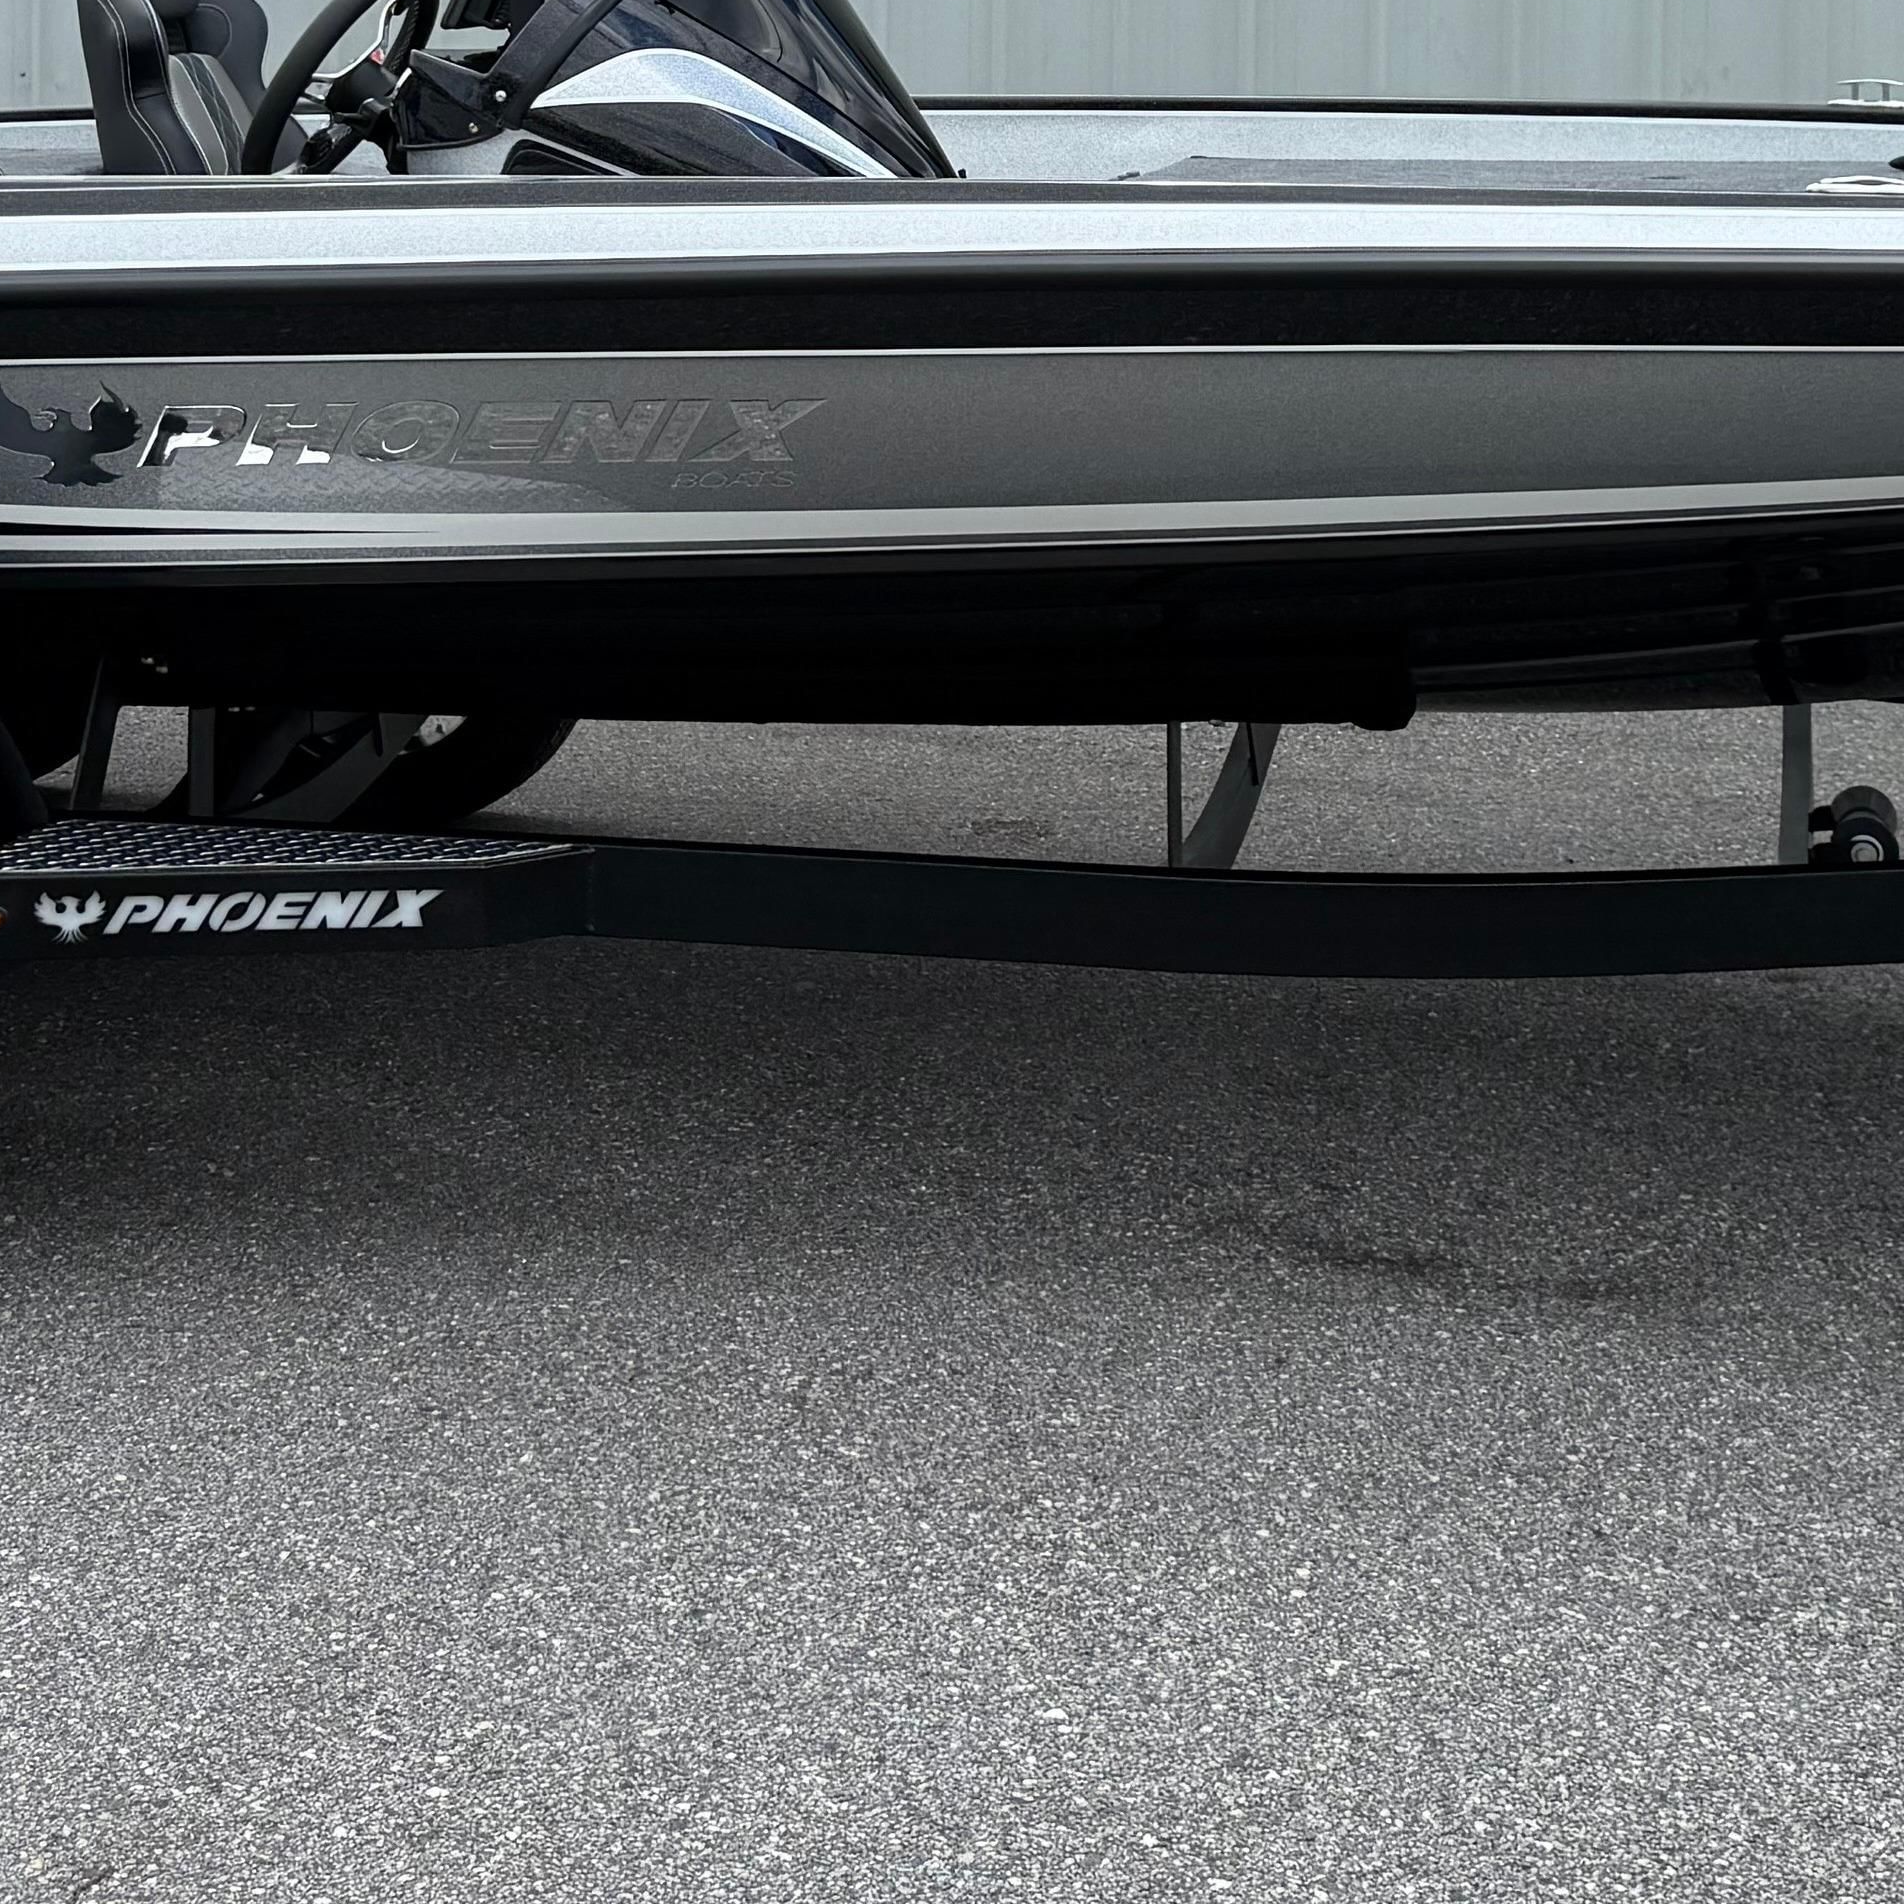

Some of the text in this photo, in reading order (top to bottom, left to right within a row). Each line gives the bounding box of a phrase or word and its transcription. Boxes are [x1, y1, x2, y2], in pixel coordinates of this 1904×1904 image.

[137, 399, 830, 469] PHOENIX
[671, 470, 797, 488] BOATS
[101, 889, 444, 935] PHOENIX
